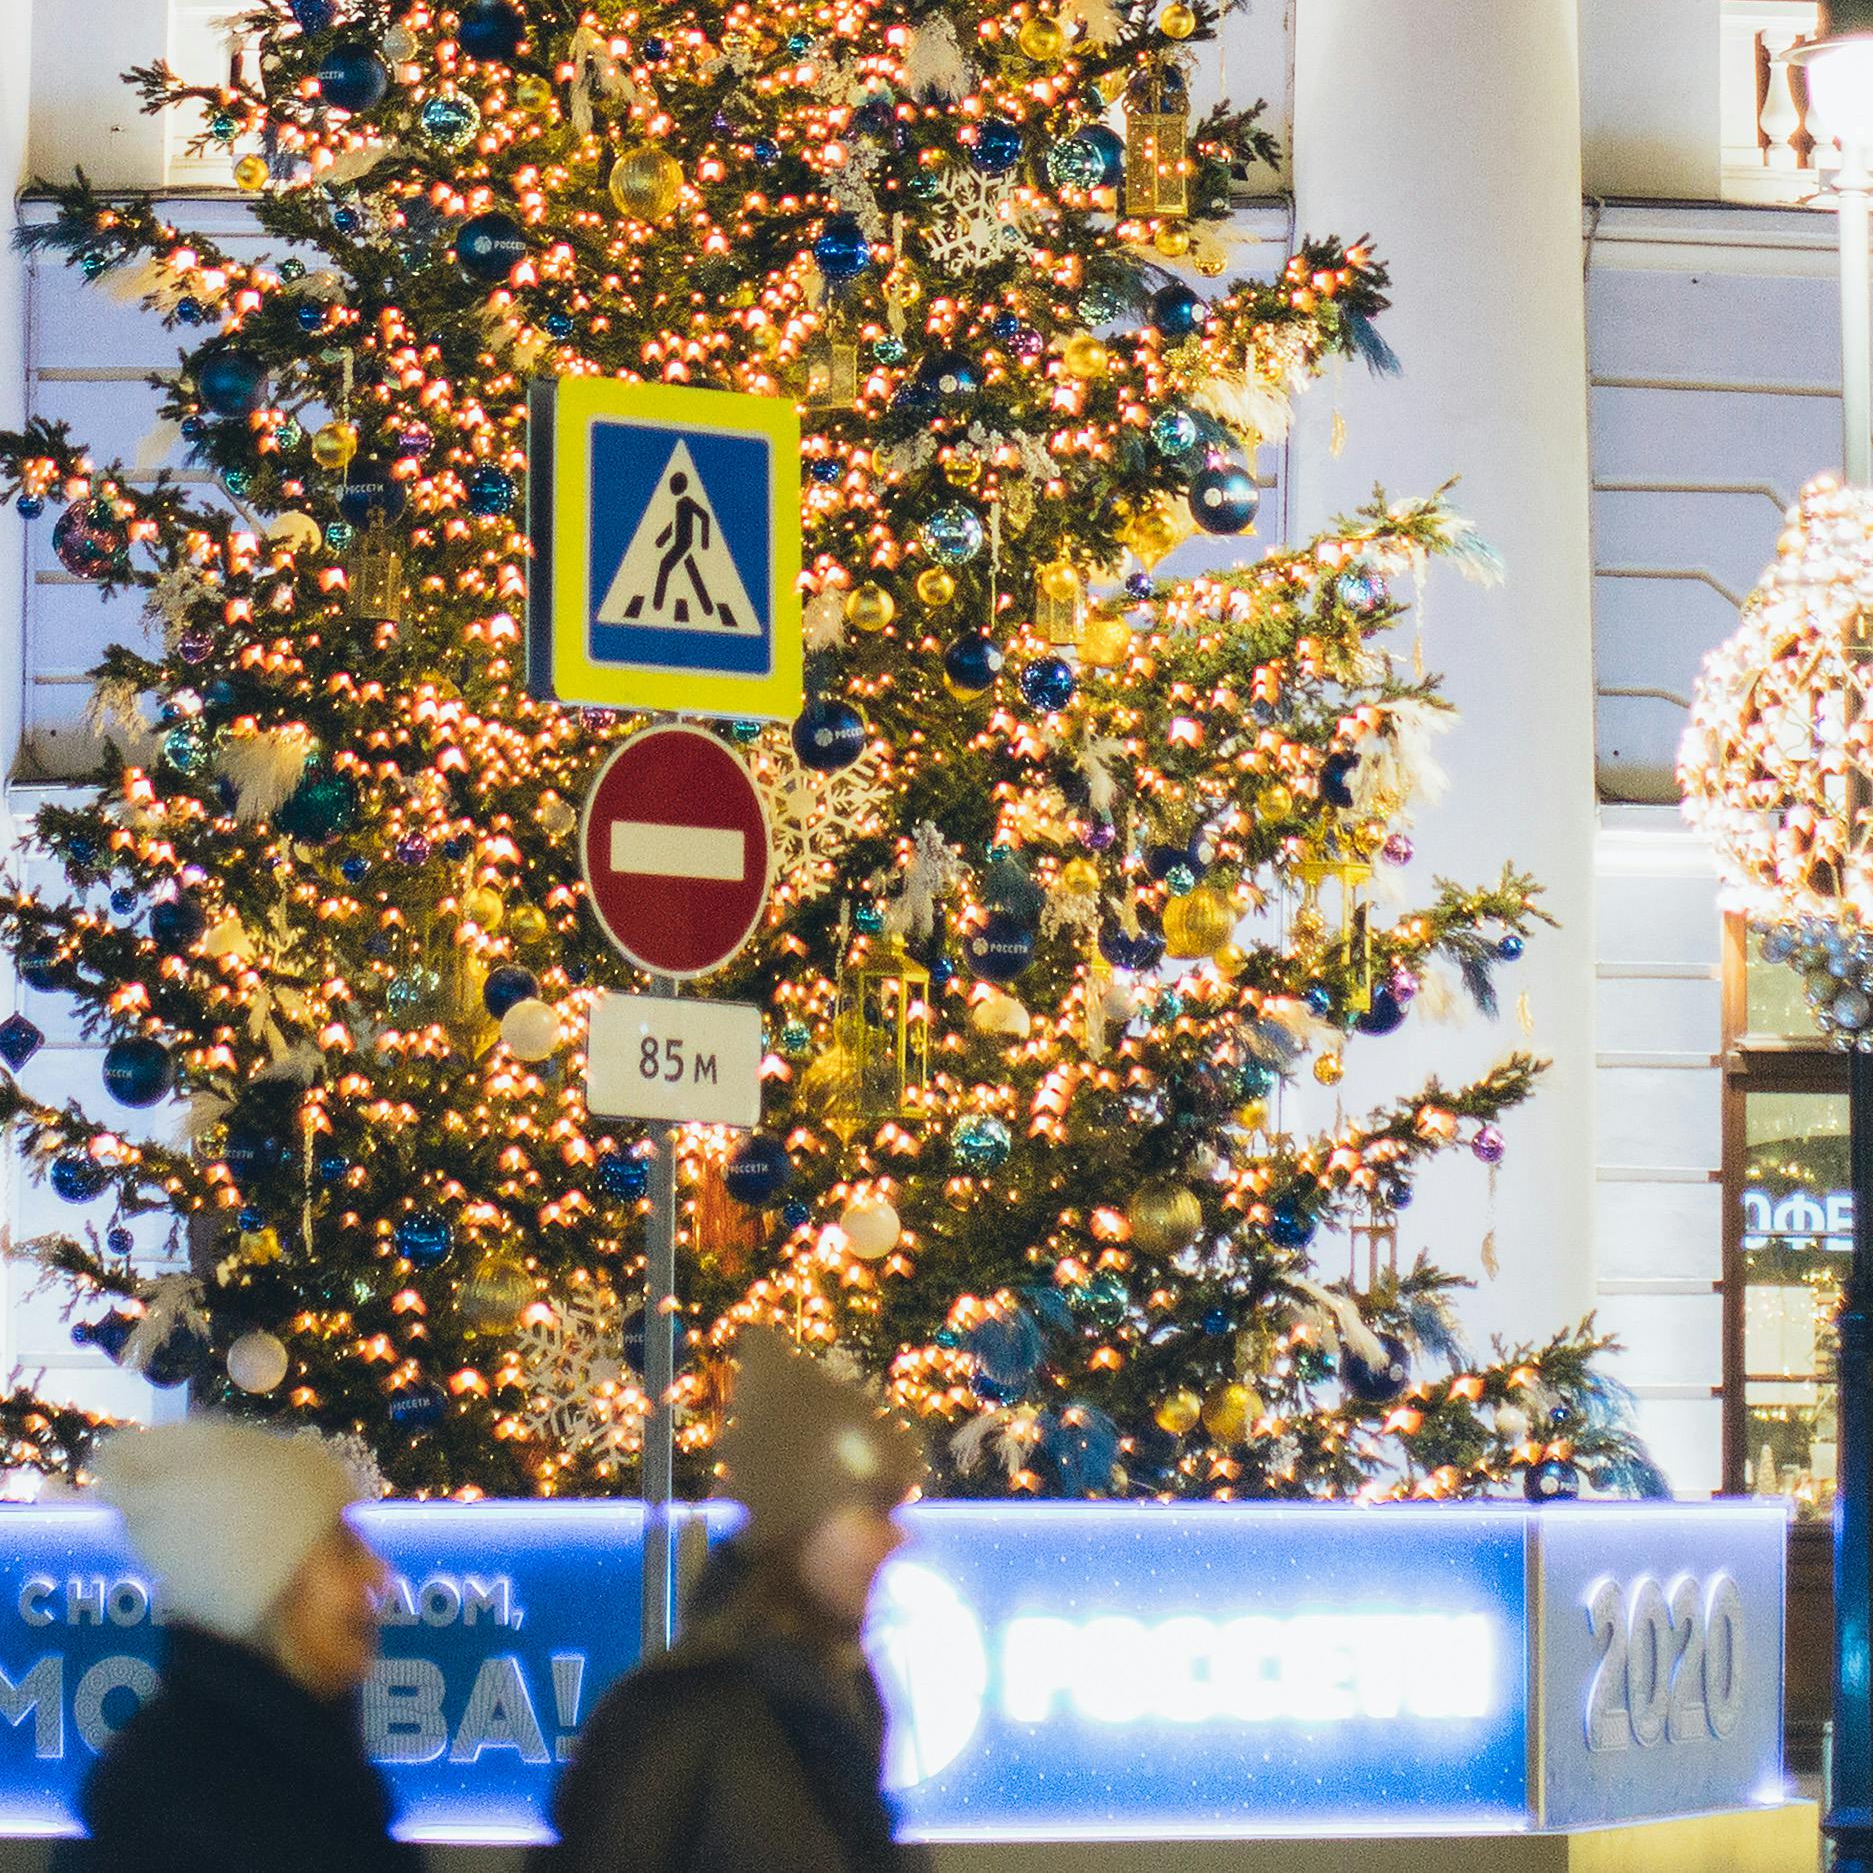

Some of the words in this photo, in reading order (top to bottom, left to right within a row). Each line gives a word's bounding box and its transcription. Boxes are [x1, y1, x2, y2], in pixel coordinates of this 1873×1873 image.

[639, 1035, 684, 1082] 85
[17, 1579, 56, 1627] С
[1582, 1572, 1744, 1752] 2020
